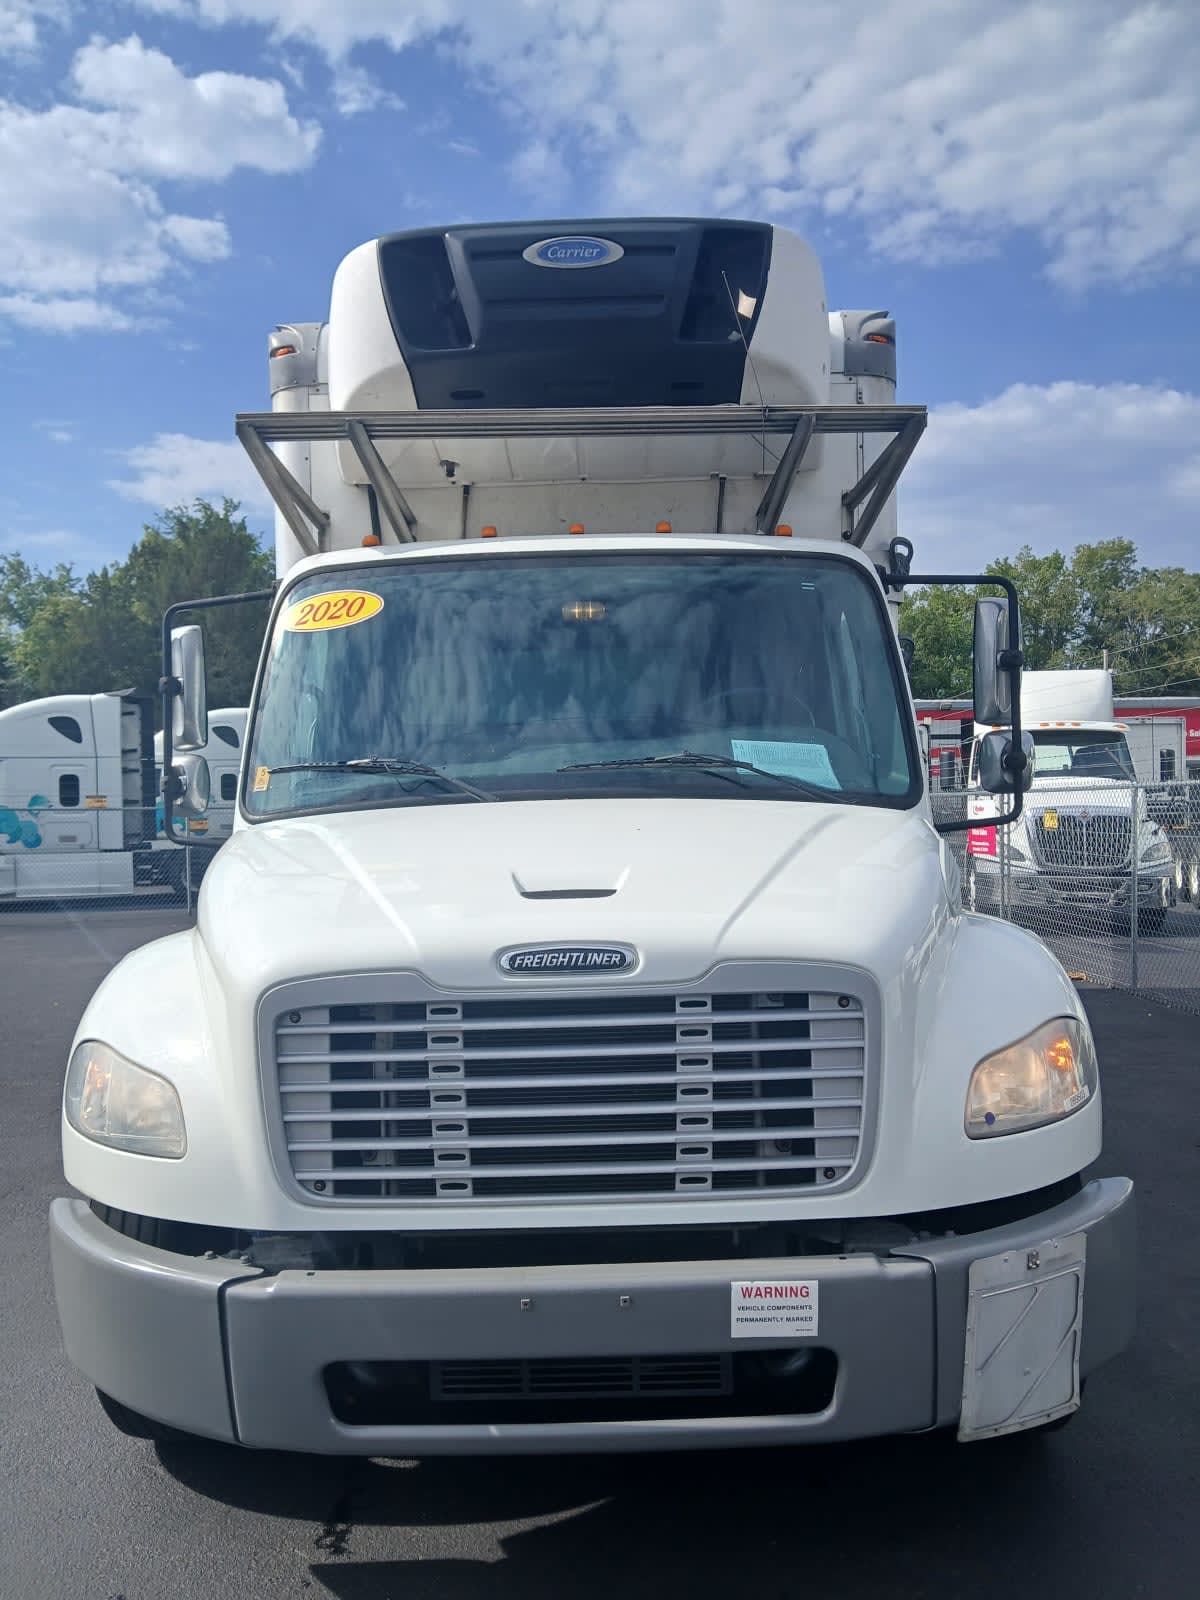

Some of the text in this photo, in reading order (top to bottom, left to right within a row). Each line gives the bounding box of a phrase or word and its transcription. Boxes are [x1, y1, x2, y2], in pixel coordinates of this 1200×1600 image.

[547, 246, 600, 258] Carrier
[295, 597, 366, 626] 2020
[514, 952, 621, 968] FREIGHTLINER
[741, 1286, 810, 1299] WARNING
